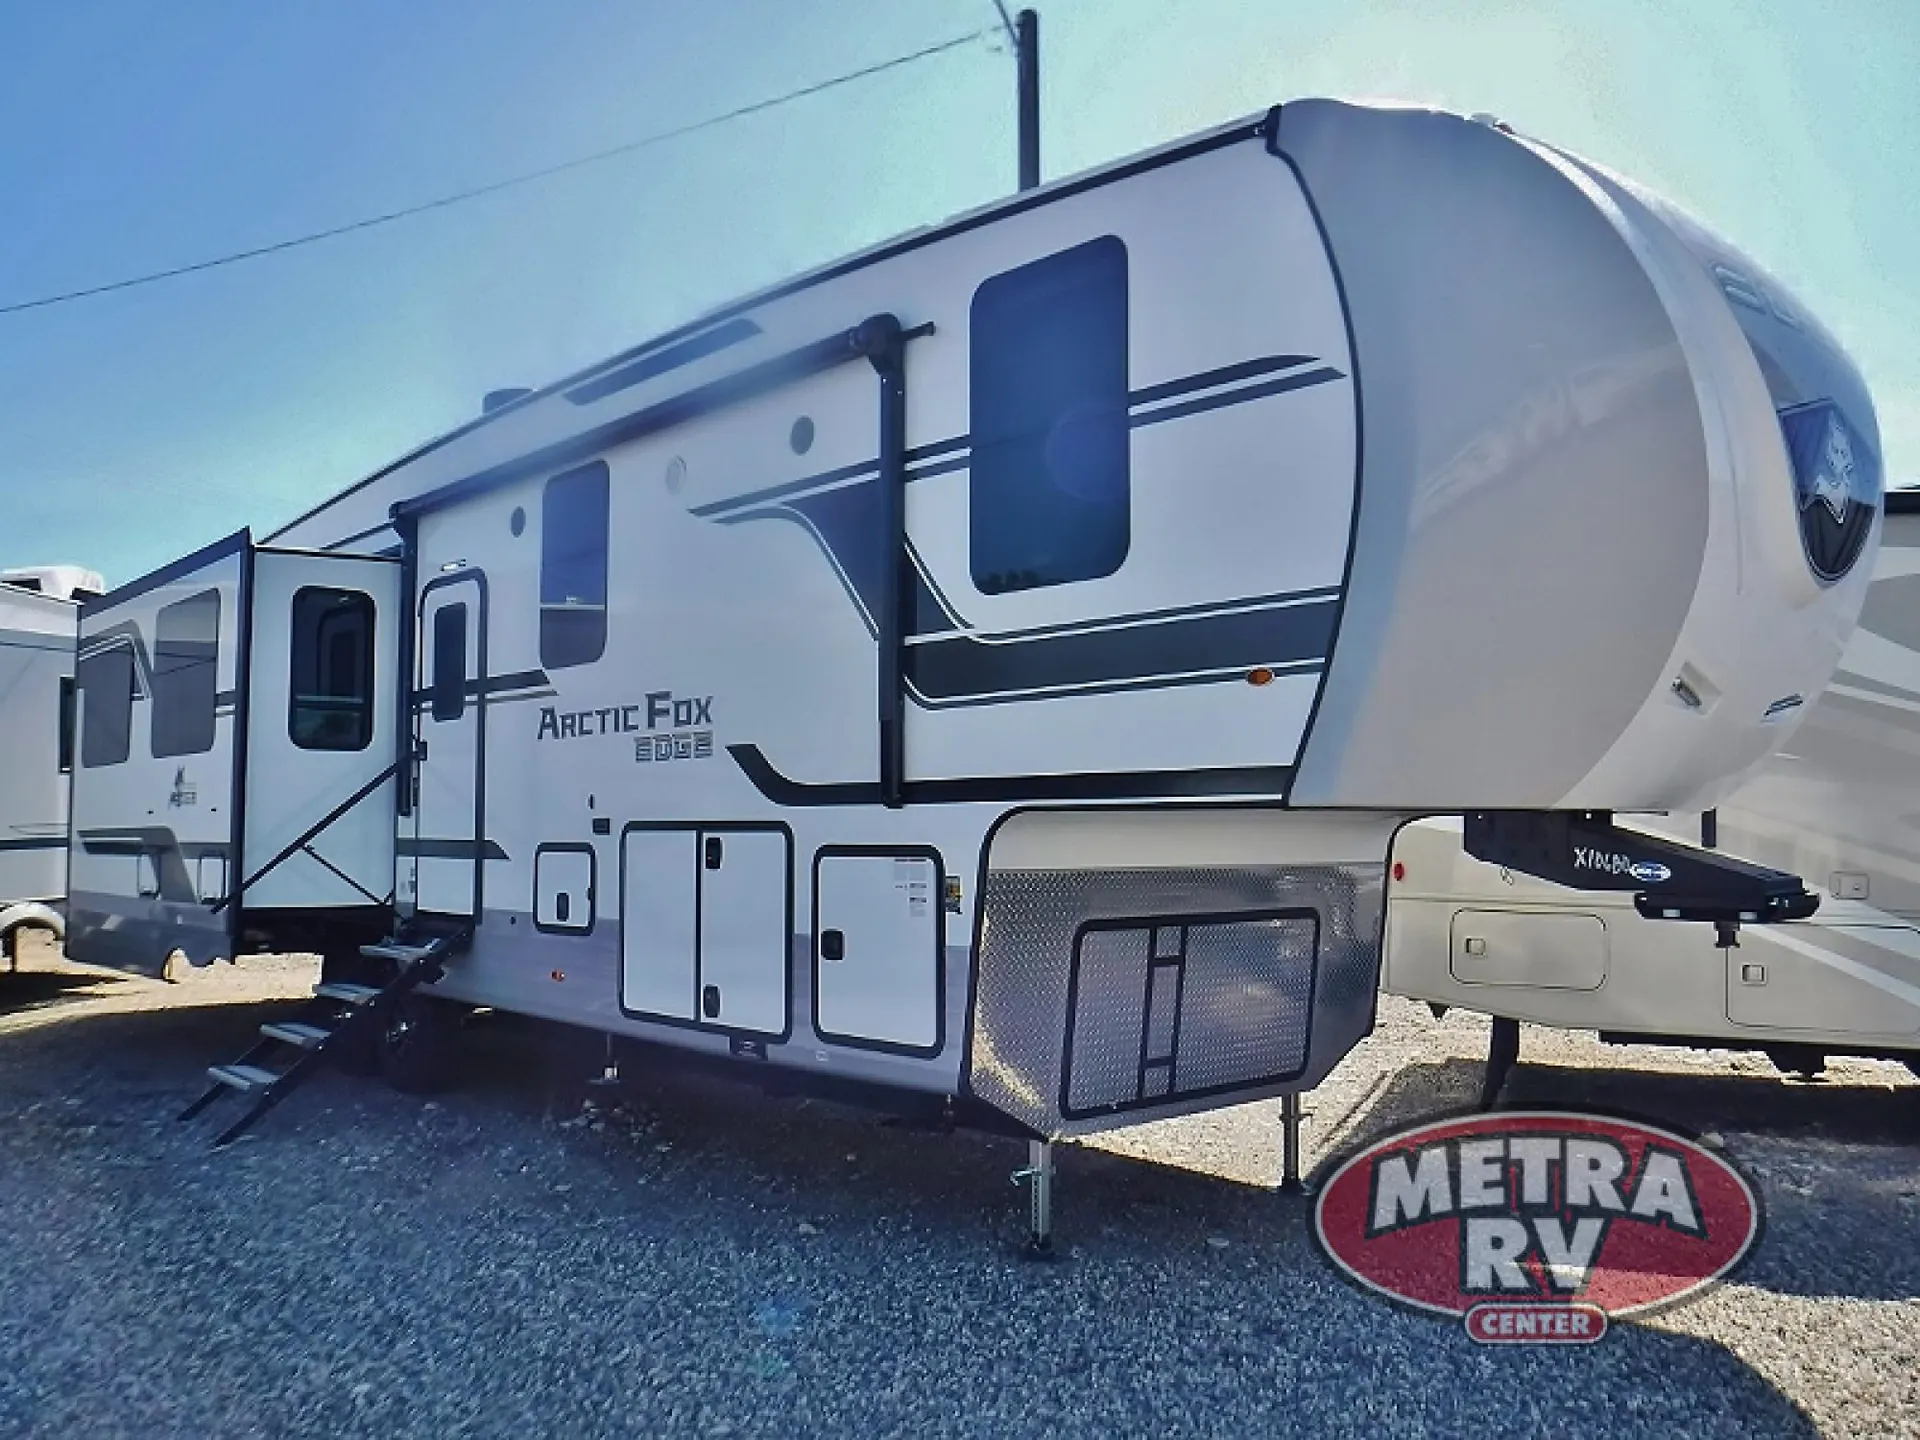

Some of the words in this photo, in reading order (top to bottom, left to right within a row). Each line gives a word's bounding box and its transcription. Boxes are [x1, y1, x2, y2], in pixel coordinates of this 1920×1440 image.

[537, 704, 640, 740] ARCTIC
[645, 690, 714, 730] FOX
[634, 731, 714, 764] EDGE
